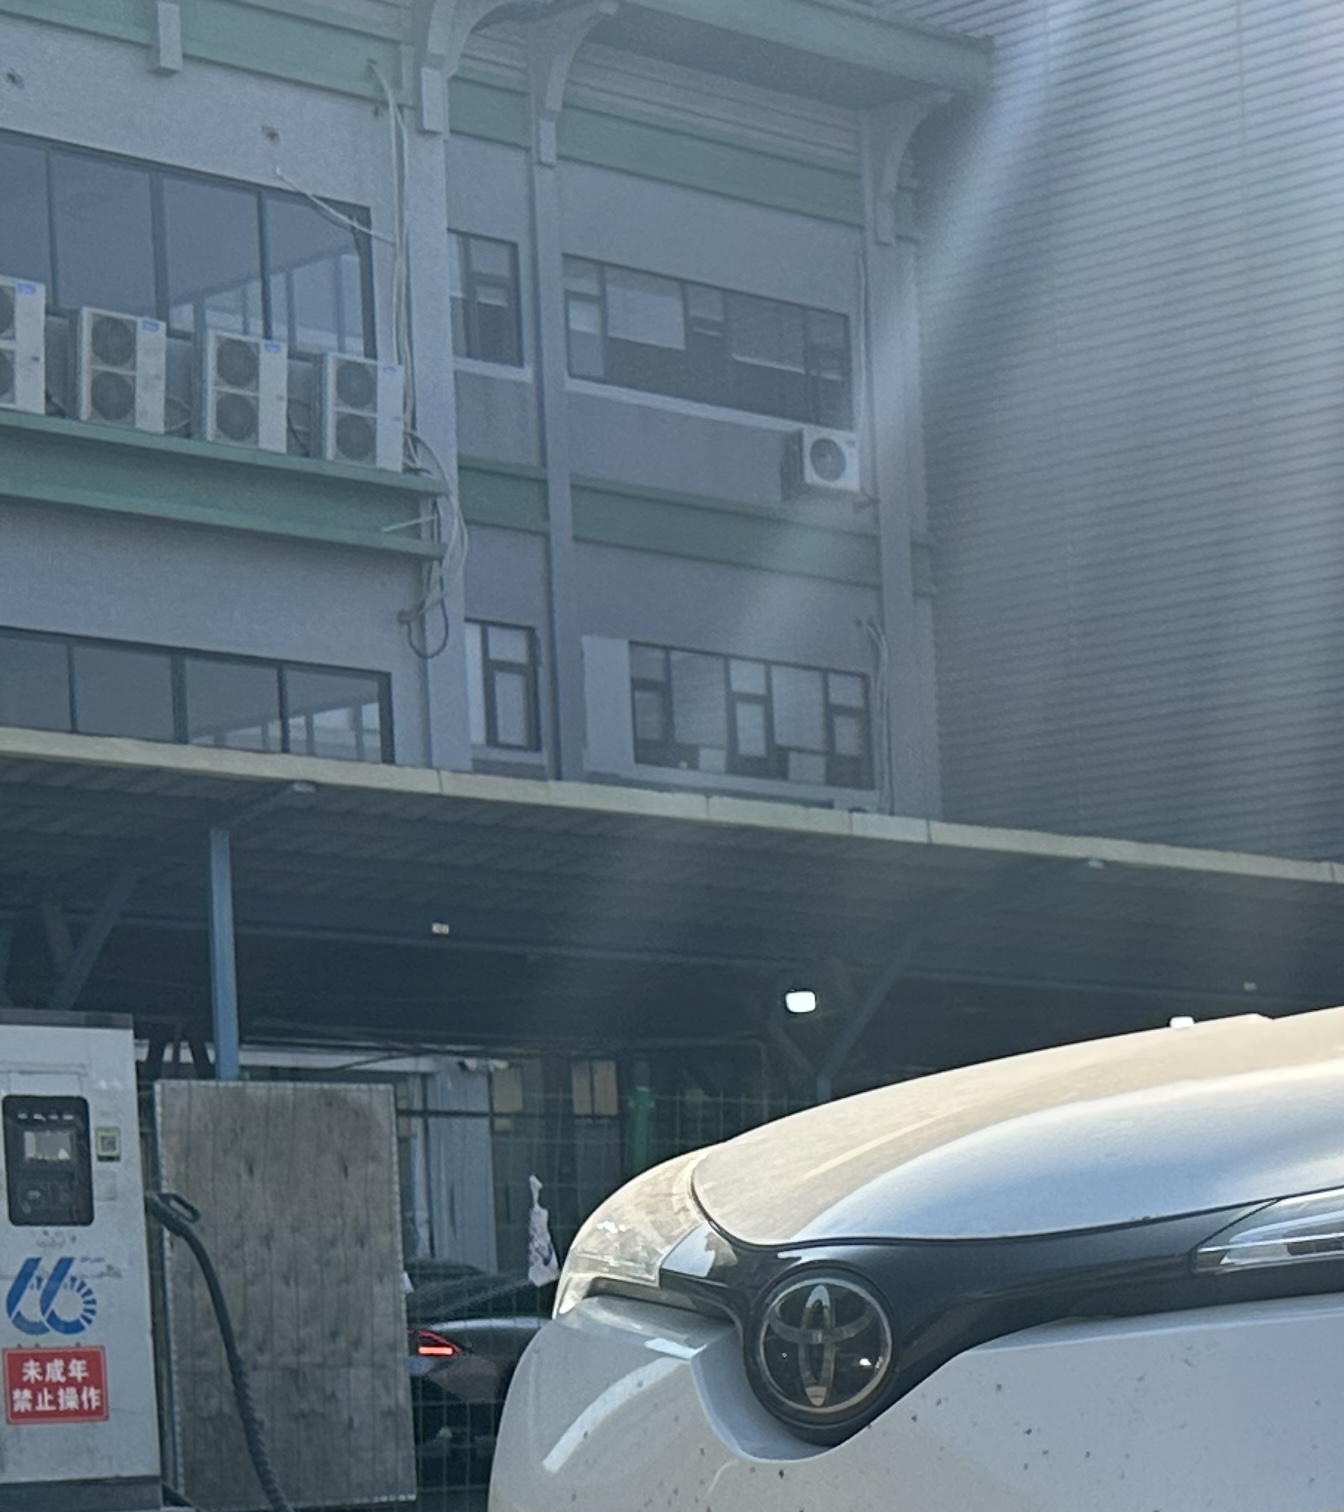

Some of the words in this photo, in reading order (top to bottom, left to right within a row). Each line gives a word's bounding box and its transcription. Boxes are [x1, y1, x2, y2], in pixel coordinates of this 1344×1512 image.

[22, 1359, 89, 1383] 未成年
[12, 1386, 101, 1412] 禁止操作
